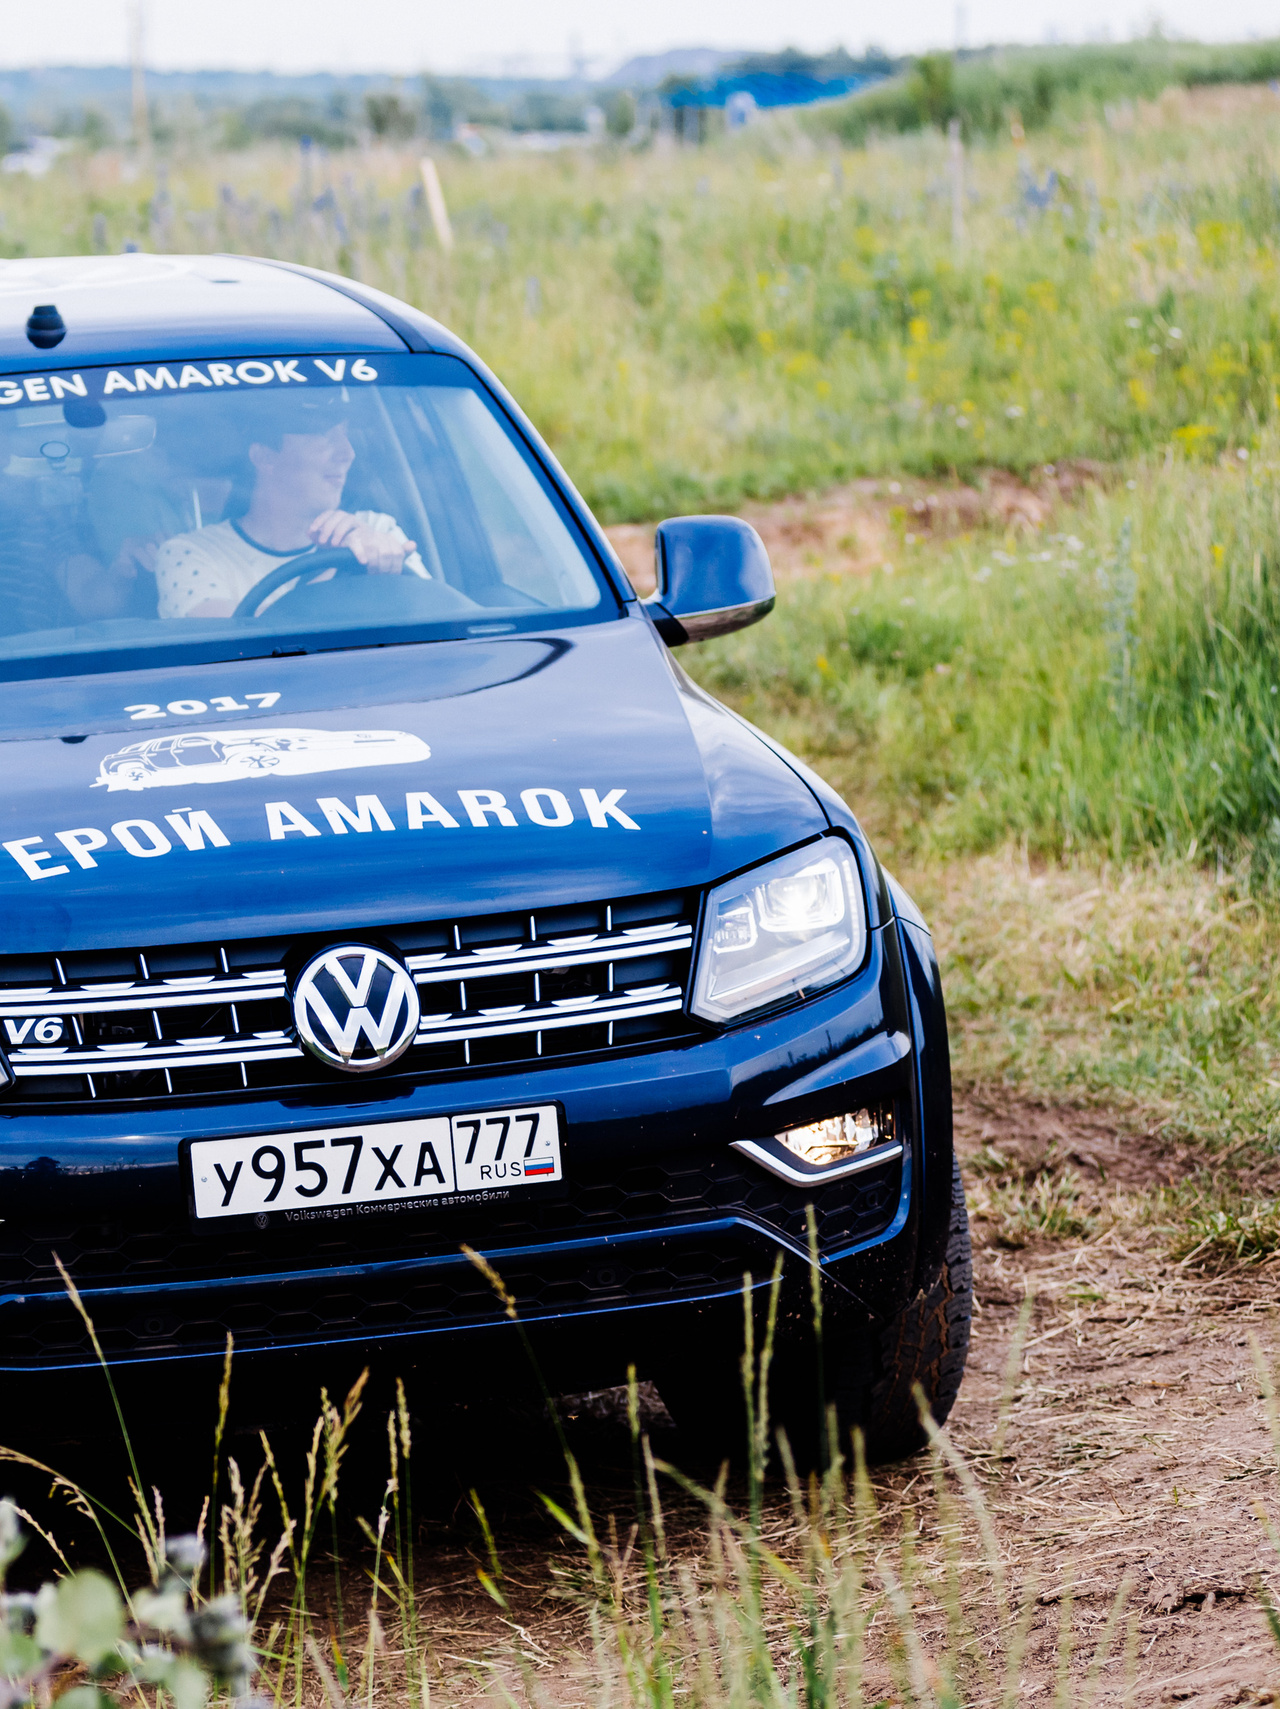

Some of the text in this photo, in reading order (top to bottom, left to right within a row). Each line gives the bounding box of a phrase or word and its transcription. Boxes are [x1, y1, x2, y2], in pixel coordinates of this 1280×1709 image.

[103, 359, 307, 394] AMAROK
[314, 357, 378, 383] V6
[123, 692, 282, 721] 2017
[265, 788, 641, 841] AMAROK
[4, 1017, 63, 1044] V6
[456, 1113, 540, 1164] 777
[480, 1162, 522, 1181] RUS
[285, 1189, 510, 1222] Volkswagen Коммерческие автомобили
